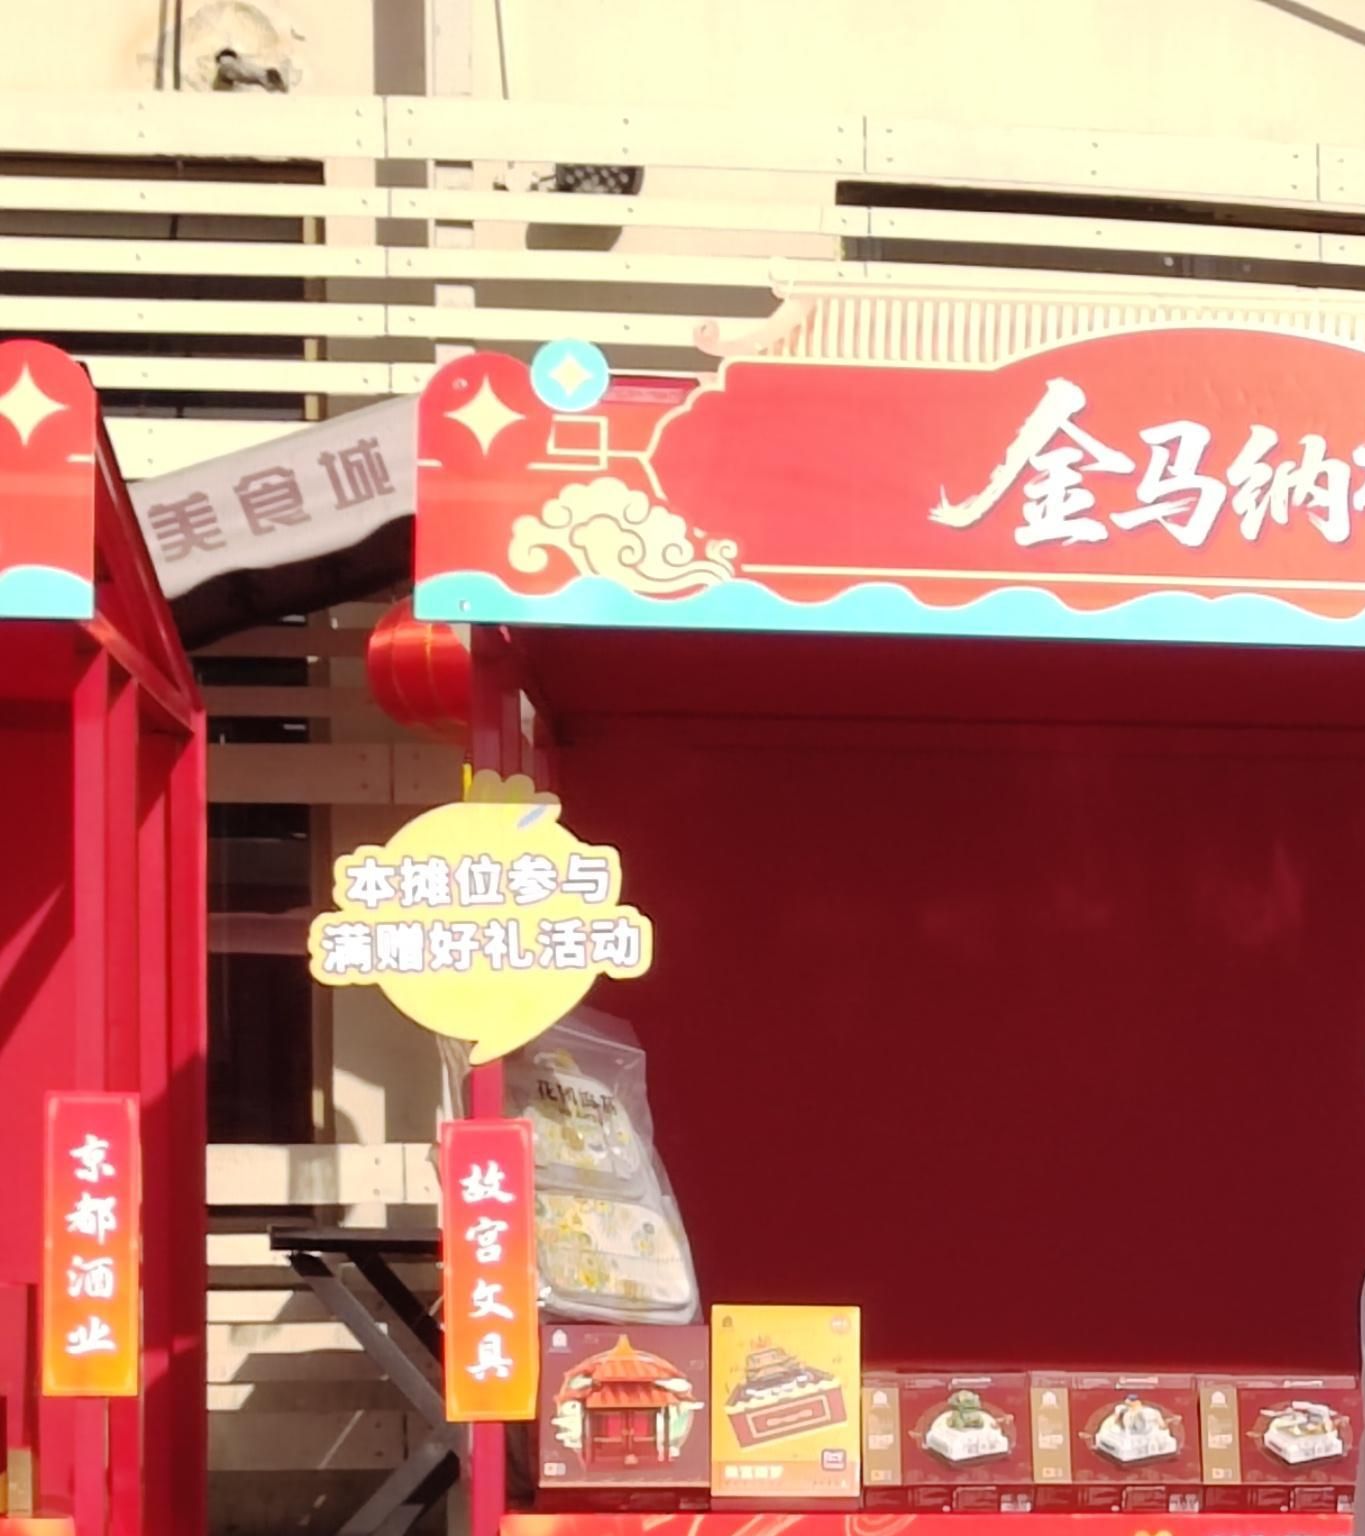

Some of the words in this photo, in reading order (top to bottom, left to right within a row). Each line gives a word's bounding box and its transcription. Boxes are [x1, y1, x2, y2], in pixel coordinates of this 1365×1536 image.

[147, 437, 396, 563] 美食城
[345, 853, 611, 909] 本摊位参与
[321, 916, 642, 974] 满赠好礼活动
[65, 1133, 117, 1355] 京都酒业
[459, 1160, 516, 1380] 故宫文具
